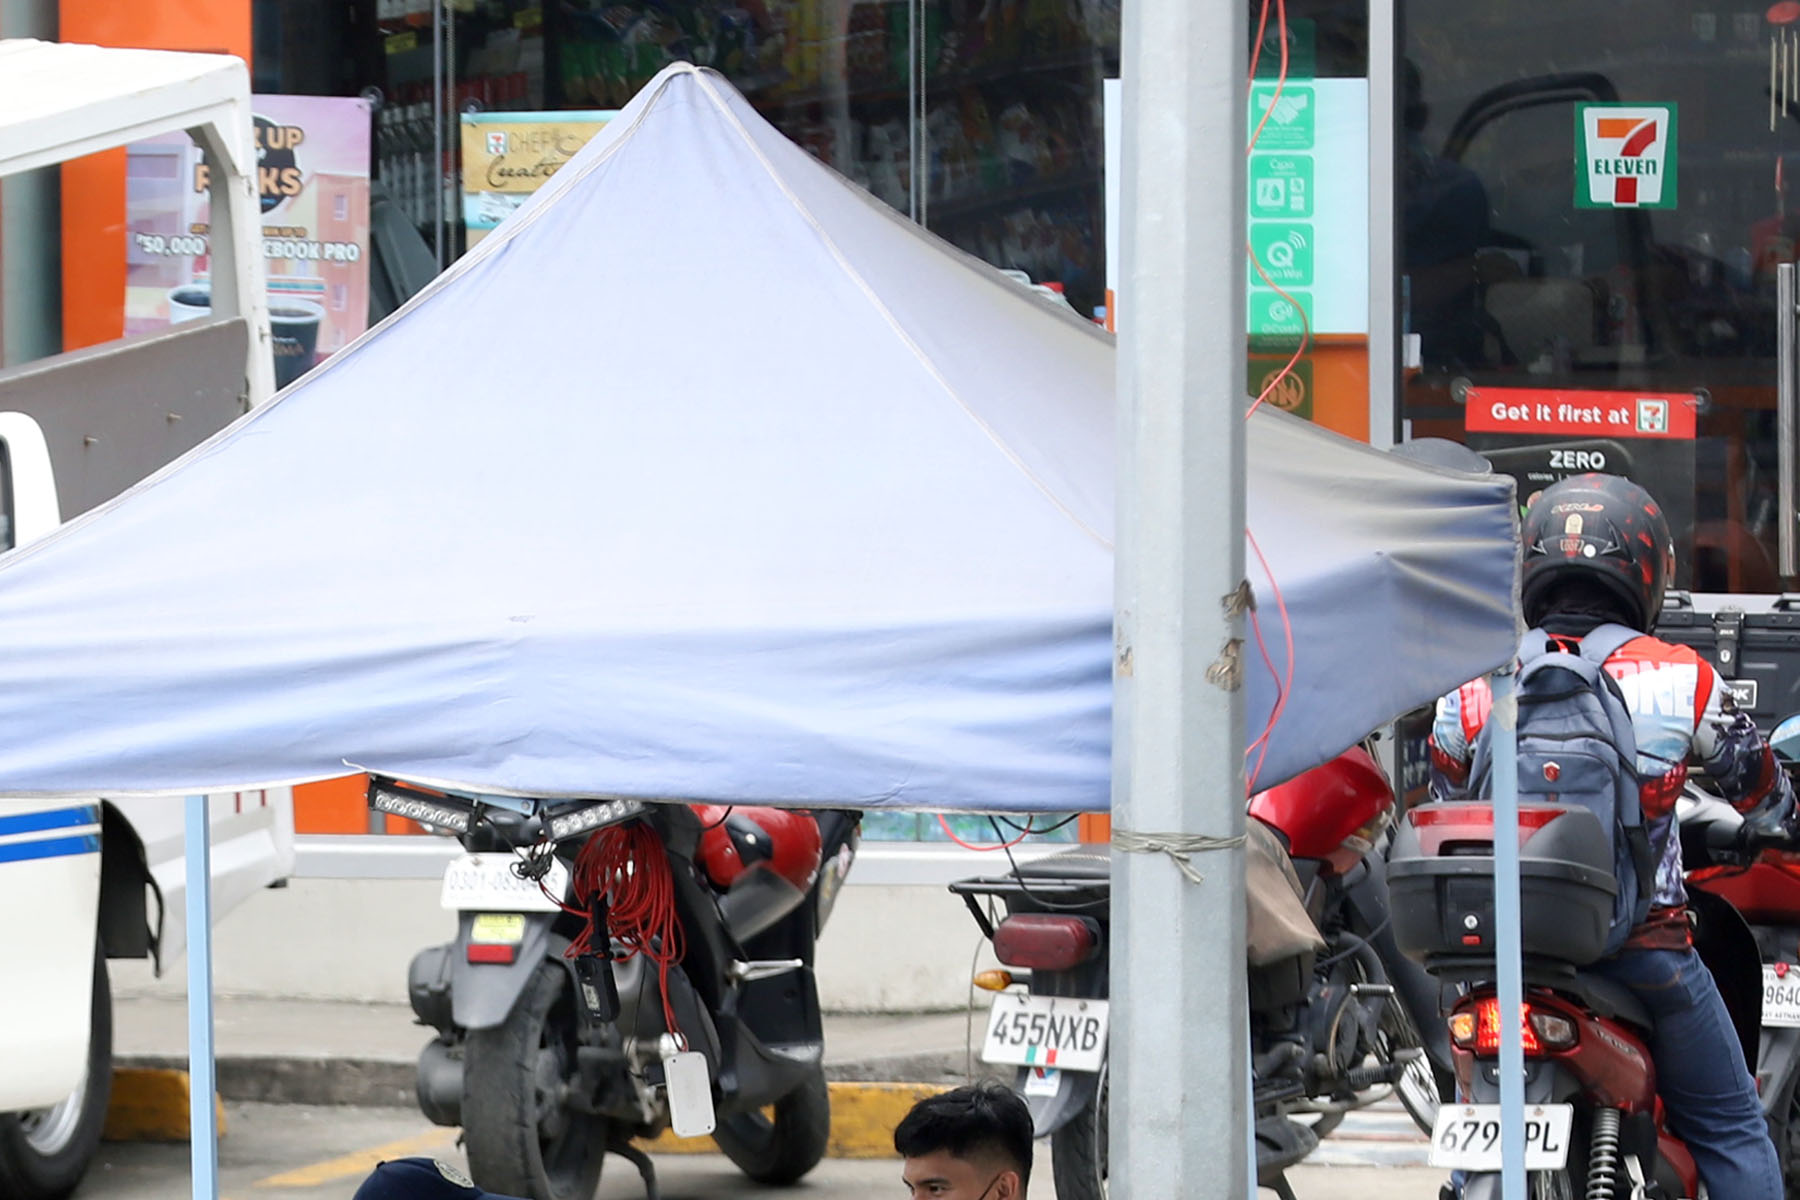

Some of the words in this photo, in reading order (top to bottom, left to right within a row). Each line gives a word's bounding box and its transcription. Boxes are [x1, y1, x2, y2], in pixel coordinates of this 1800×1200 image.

[266, 129, 303, 150] UP
[194, 164, 302, 196] PKS
[323, 243, 360, 261] PRO
[1491, 403, 1530, 421] Get
[1536, 404, 1552, 421] it
[1558, 405, 1602, 423] first
[1607, 408, 1629, 424] at
[1550, 451, 1606, 470] ZERO
[992, 1011, 1100, 1051] 455NXB
[1440, 1121, 1559, 1153] 679PL
